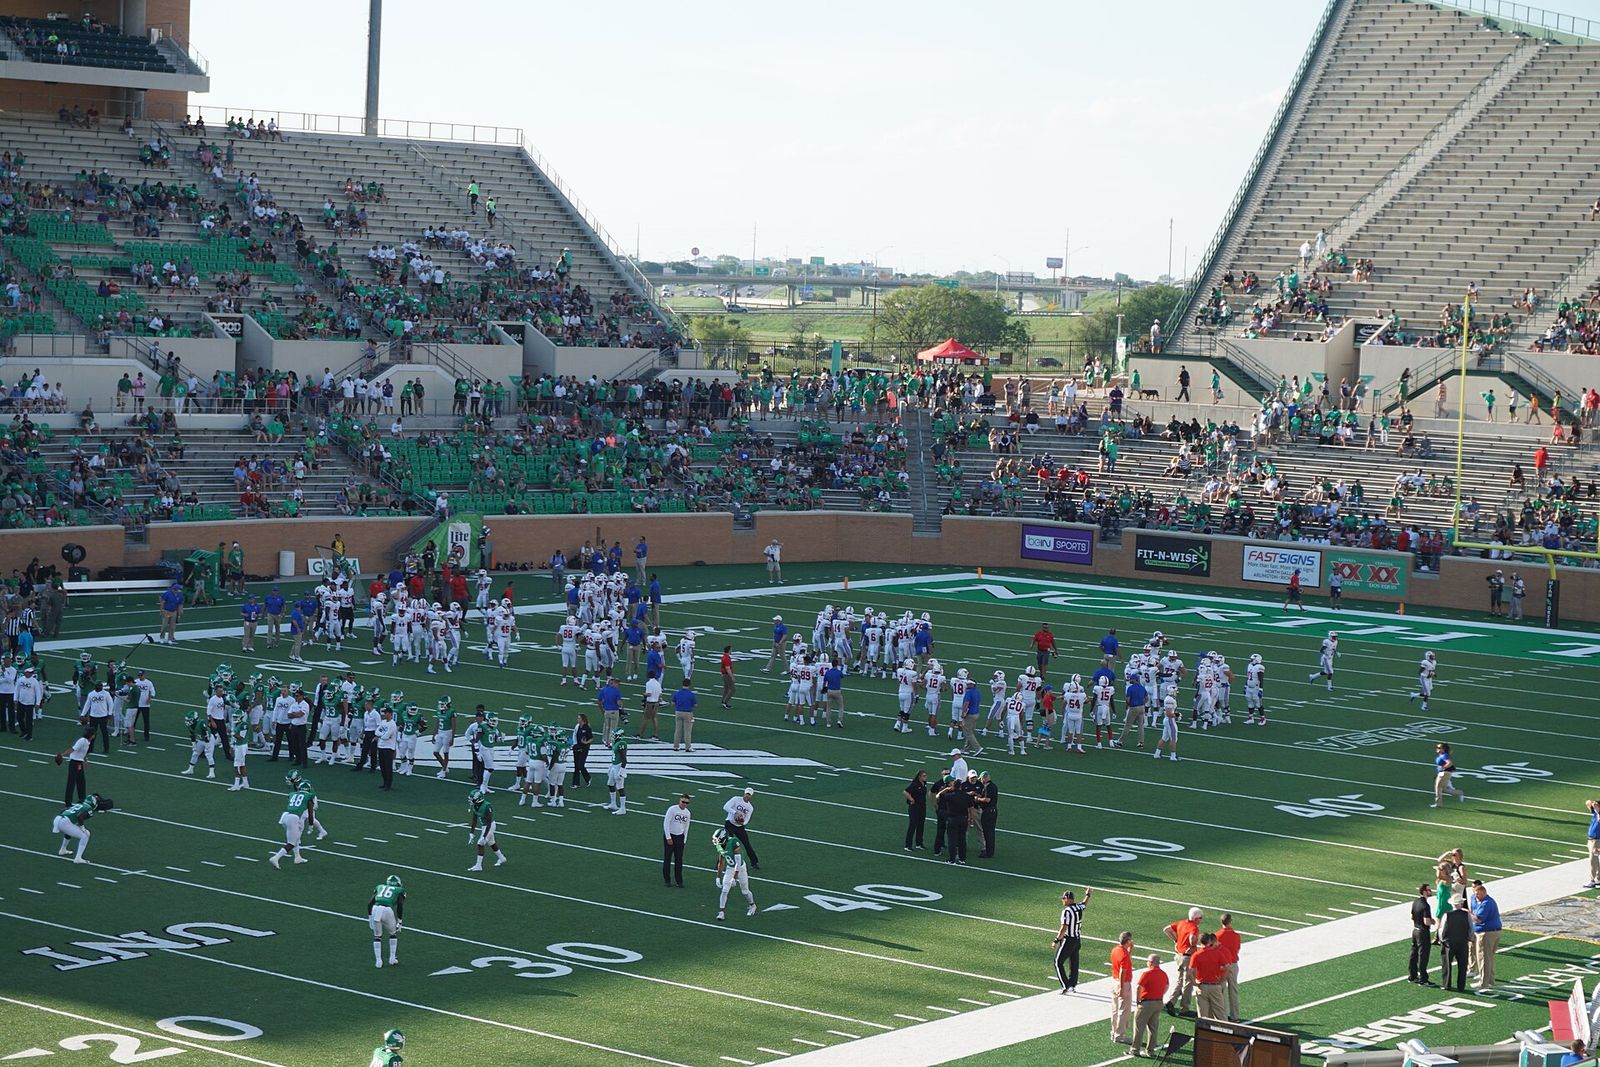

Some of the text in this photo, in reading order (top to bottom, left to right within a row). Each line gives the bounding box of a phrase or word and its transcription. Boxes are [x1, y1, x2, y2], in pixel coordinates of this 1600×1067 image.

[450, 530, 469, 543] Lite
[1056, 540, 1087, 552] SPORTS
[1137, 549, 1198, 563] FIT-N-WISE
[1248, 551, 1315, 566] FASTSIGNS
[1367, 564, 1401, 586] XX
[912, 584, 1493, 642] NORTH
[800, 670, 810, 681] 89
[929, 678, 938, 689] 12
[954, 682, 963, 695] 18
[1027, 681, 1037, 692] 78
[1068, 699, 1080, 709] 54
[1100, 691, 1110, 702] 15
[1009, 700, 1022, 712] 20
[1449, 764, 1554, 784] 30
[1273, 797, 1386, 819] 40
[1050, 836, 1186, 863] 50
[804, 884, 944, 913] 40
[22, 921, 277, 972] UNT
[470, 942, 644, 979] 30
[1301, 997, 1497, 1057] LEADERS
[58, 1015, 264, 1065] 20
